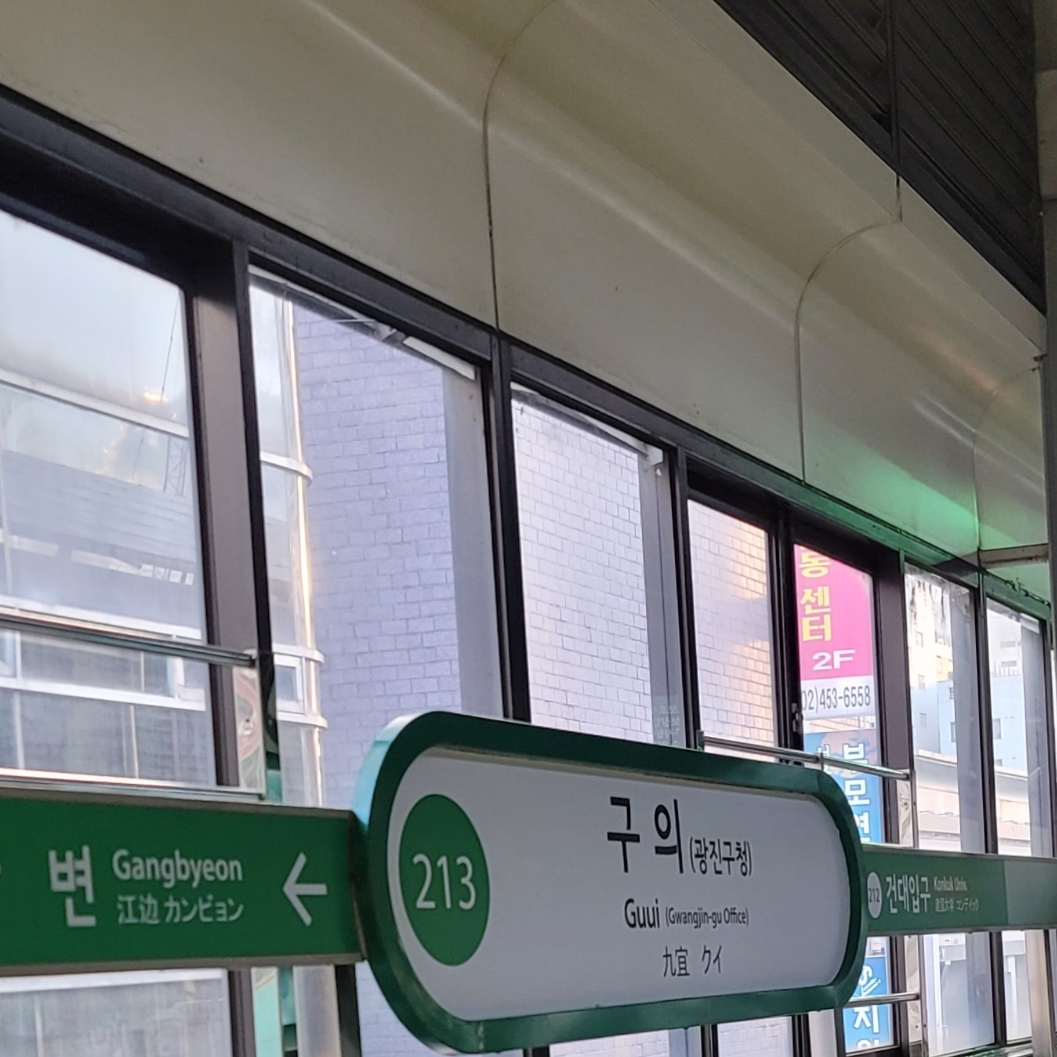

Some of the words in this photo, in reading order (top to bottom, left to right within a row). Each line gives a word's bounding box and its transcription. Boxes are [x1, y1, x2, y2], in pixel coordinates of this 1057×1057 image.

[798, 546, 833, 579] 동
[800, 585, 832, 642] 센터
[811, 649, 856, 671] 2F
[607, 796, 683, 874] 구의
[689, 836, 753, 877] (광진구청)
[112, 849, 243, 888] Gangbyeon
[412, 853, 476, 910] 213
[933, 875, 954, 892] Konkuk
[886, 874, 931, 914] 건대입구
[624, 897, 660, 929] Guui
[665, 906, 722, 929] (Gwangjin-gu
[723, 906, 749, 927] Office)
[662, 945, 690, 978] 九宜
[701, 944, 722, 974] クイ
